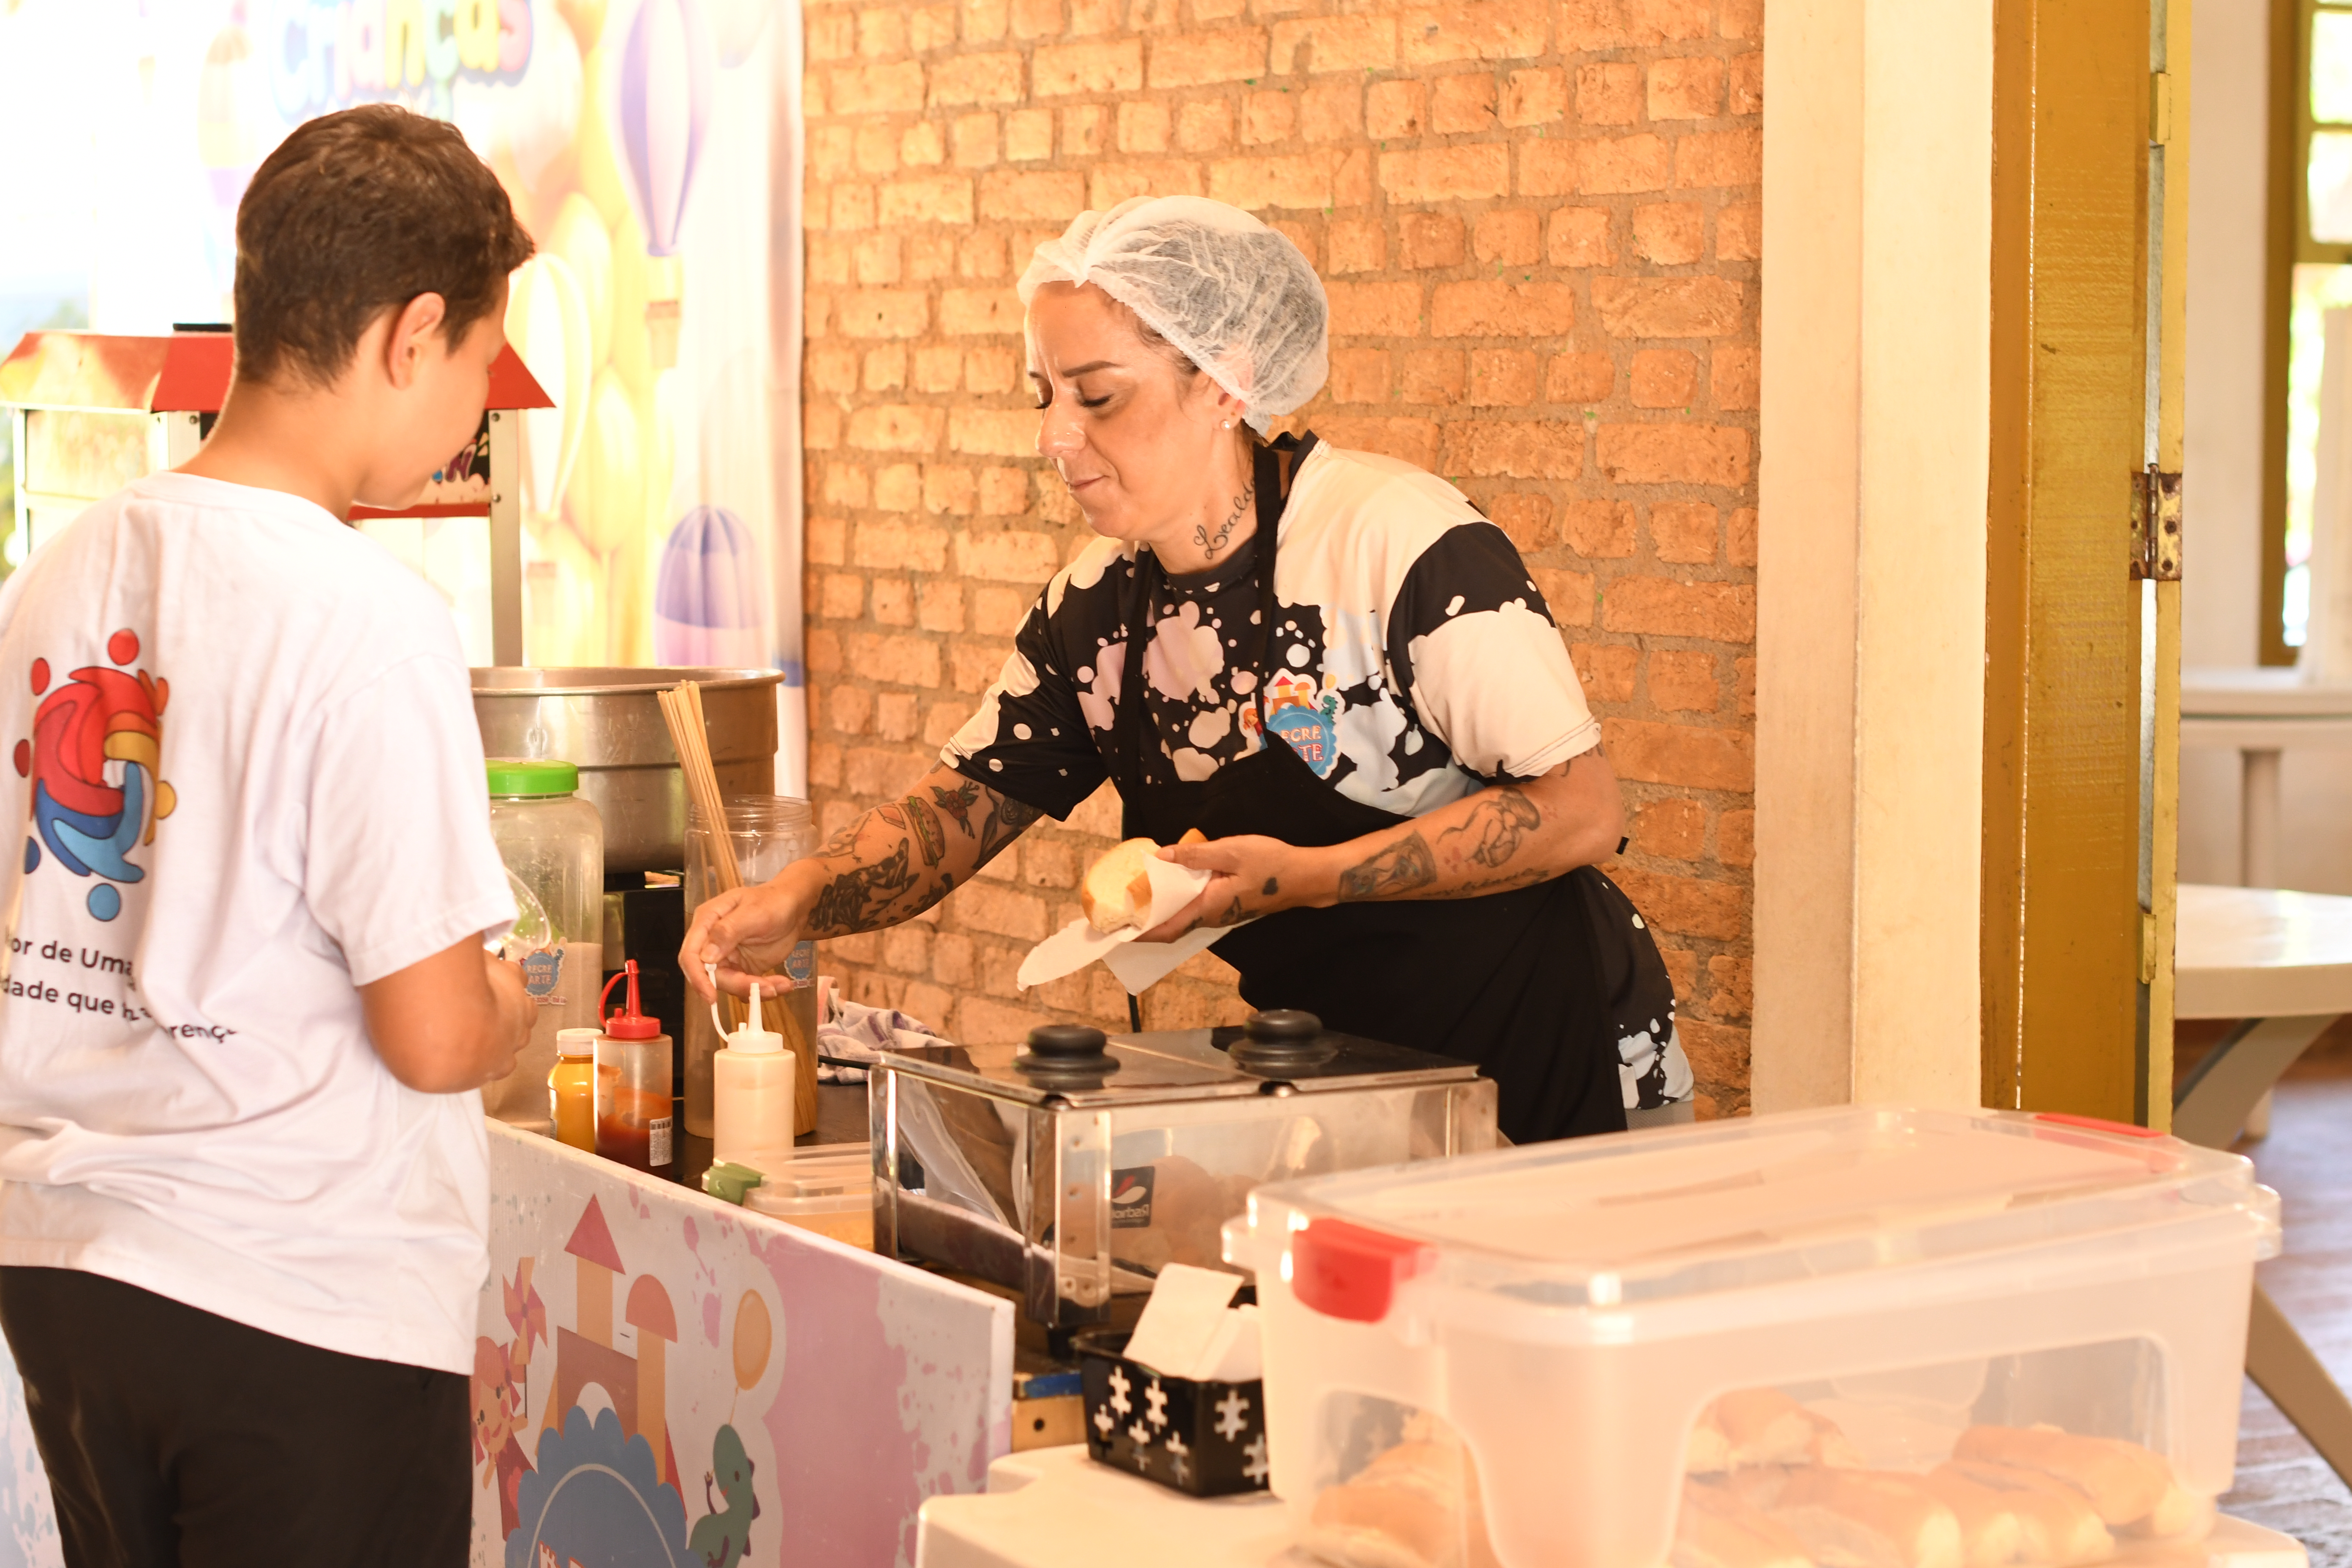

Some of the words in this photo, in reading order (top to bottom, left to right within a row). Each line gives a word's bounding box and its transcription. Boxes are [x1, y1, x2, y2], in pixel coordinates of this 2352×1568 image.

[1280, 725, 1322, 743] ECRE
[1293, 743, 1324, 762] TE
[41, 940, 72, 963] de
[67, 992, 114, 1013] que
